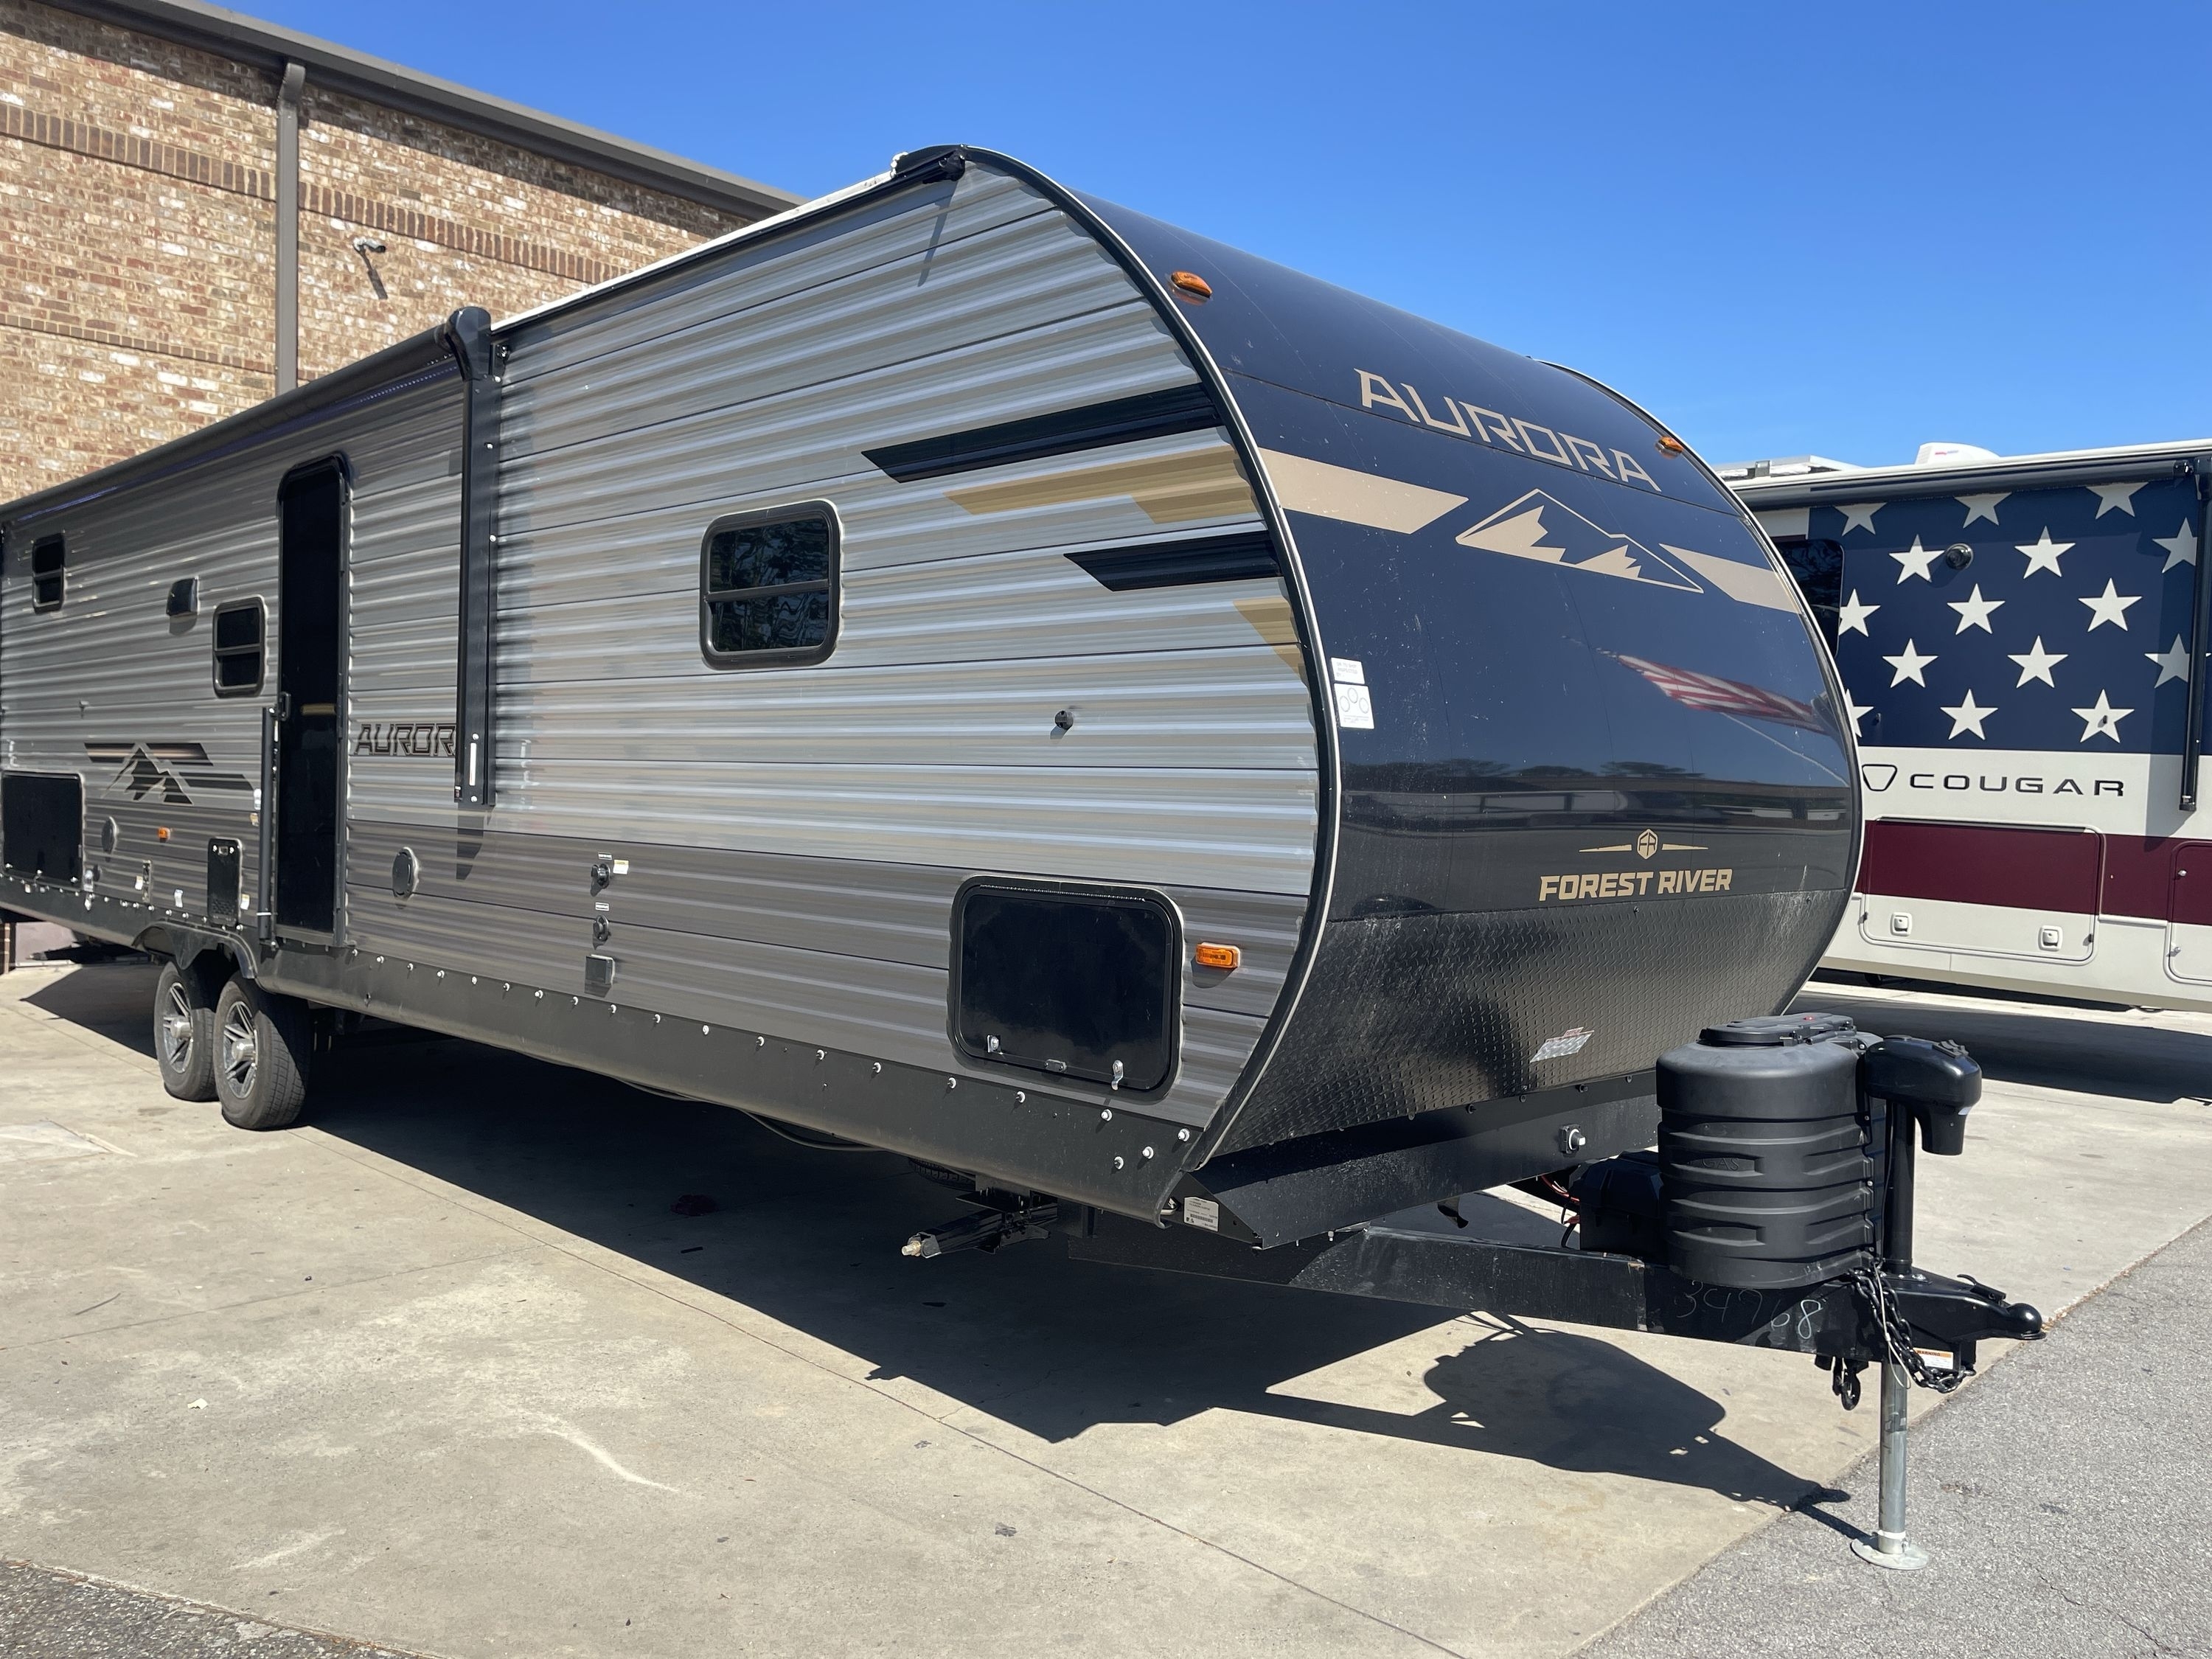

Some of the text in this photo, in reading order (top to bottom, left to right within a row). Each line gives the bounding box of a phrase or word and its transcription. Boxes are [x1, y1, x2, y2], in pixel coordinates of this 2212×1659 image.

[1354, 368, 1662, 492] AURORA
[353, 723, 456, 756] AUROR
[1910, 773, 2124, 796] COUGAR
[1539, 869, 1733, 901] FOREST RIVER
